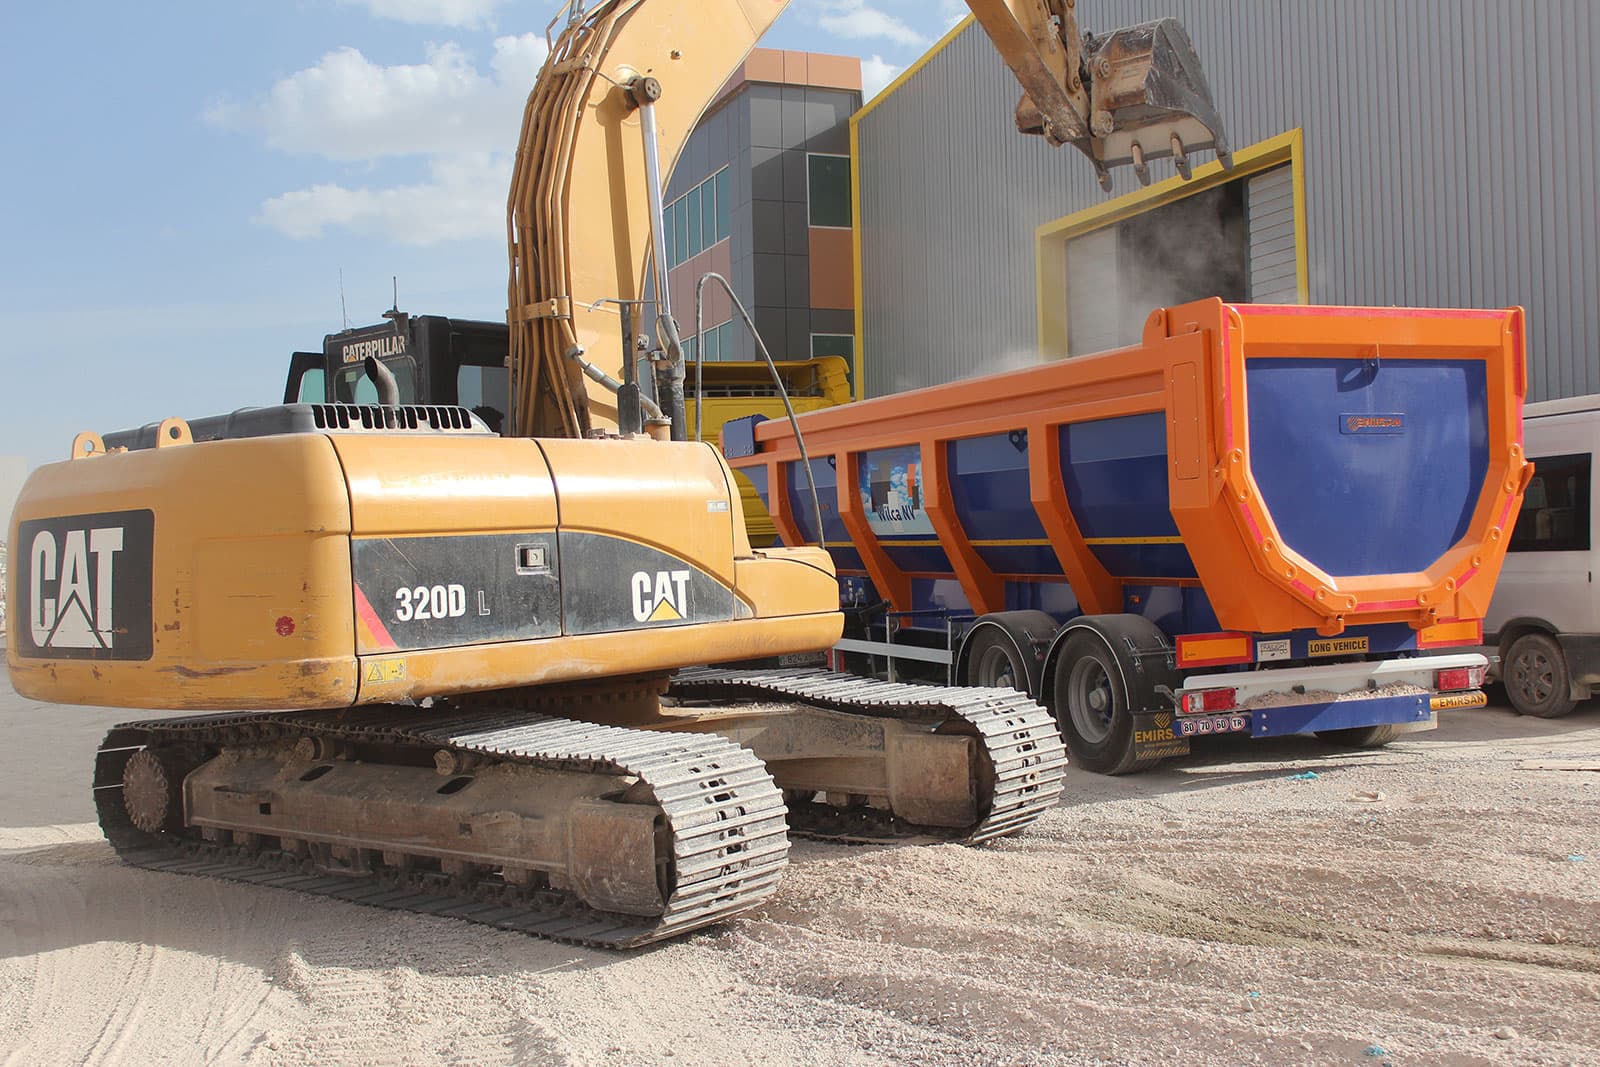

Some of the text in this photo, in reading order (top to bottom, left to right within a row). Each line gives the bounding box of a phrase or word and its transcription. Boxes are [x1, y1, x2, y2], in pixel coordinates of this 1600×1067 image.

[343, 335, 405, 363] CATERPILLAR
[877, 504, 916, 522] Wilca NV
[31, 527, 124, 648] CAT
[632, 570, 691, 622] CAT
[395, 584, 491, 622] 320D L
[1310, 640, 1367, 653] LONG VEHICLE
[1439, 694, 1484, 707] EMIRSAN
[1232, 719, 1242, 728] TR
[1135, 728, 1176, 743] EMIRS
